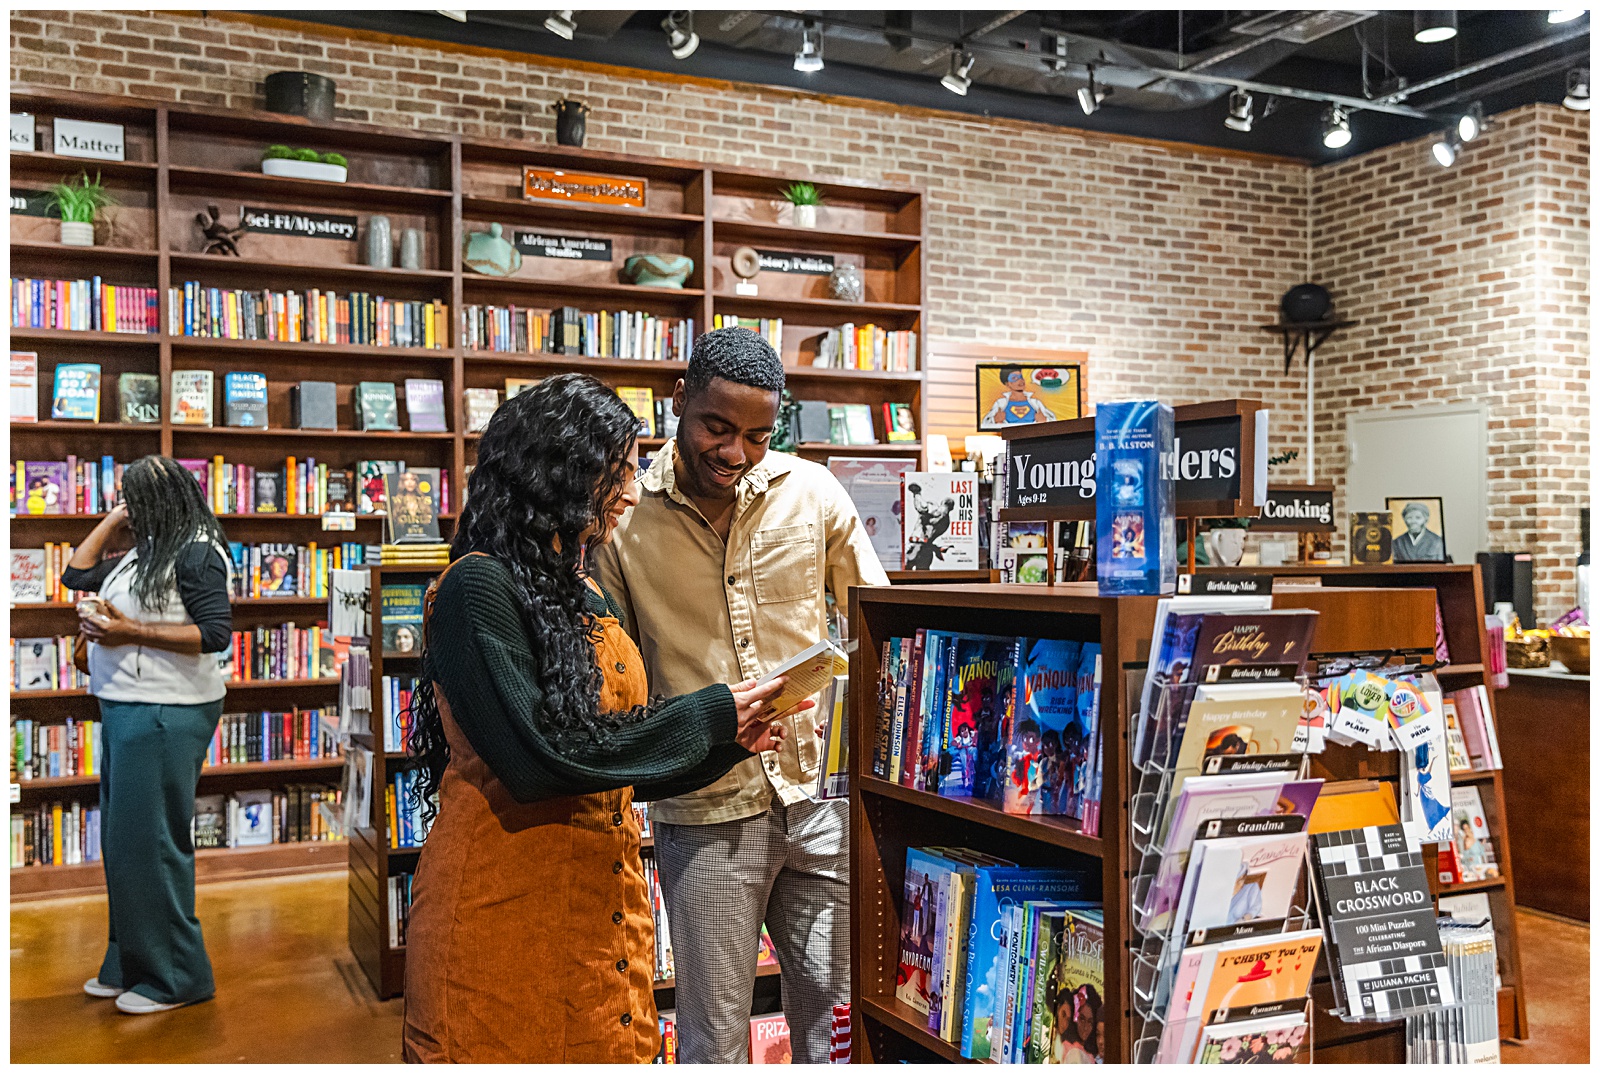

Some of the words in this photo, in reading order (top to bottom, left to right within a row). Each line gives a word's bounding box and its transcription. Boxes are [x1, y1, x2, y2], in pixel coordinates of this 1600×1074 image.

[58, 134, 122, 153] Matter
[247, 213, 356, 238] Sci-Fi/Mystery
[520, 234, 558, 248] African
[560, 238, 606, 251] American
[544, 247, 582, 259] Studies
[1118, 441, 1155, 449] ALSTON
[1013, 453, 1097, 499] Young
[951, 480, 973, 494] LAST
[959, 494, 973, 508] ON
[1018, 494, 1032, 507] Ages
[1032, 493, 1047, 503] 9-12
[958, 509, 973, 521] HIS
[1264, 499, 1331, 524] Cooking
[951, 521, 973, 536] FEET
[261, 543, 296, 556] ELLA
[1206, 580, 1257, 592] Birthday-Male
[1233, 625, 1261, 634] HAPPY
[1212, 631, 1271, 659] Birthday
[1231, 668, 1262, 679] Birthday
[1263, 667, 1281, 677] Male
[1360, 686, 1382, 703] LOVER
[897, 695, 905, 717] ELLIS
[1038, 705, 1074, 716] WRECKING
[942, 690, 953, 750] VANQUISHERS
[1202, 712, 1231, 723] Happy
[1231, 709, 1267, 720] Birthday
[1344, 720, 1370, 734] PLANT
[1410, 725, 1431, 739] PRIDE
[893, 718, 904, 757] JOHNSON
[879, 733, 890, 761] STAR
[1231, 759, 1290, 771] Birthday-Female
[1237, 820, 1285, 833] Grandma
[991, 884, 1010, 893] LESA
[1012, 884, 1080, 893] CLINE-RANSOME
[1354, 876, 1399, 895] BLACK
[1336, 889, 1425, 914] CROSSWORD
[1232, 925, 1254, 935] Mom
[1355, 924, 1370, 935] 100
[1370, 921, 1387, 933] Mini
[1387, 918, 1416, 931] Puzzles
[968, 922, 978, 949] ONE
[1368, 931, 1406, 942] CELEBRATING
[1353, 946, 1365, 954] THE
[1365, 944, 1392, 955] African
[1392, 939, 1427, 954] Diaspora
[966, 950, 976, 971] BIG
[1009, 931, 1019, 985] MONTGOMERY
[1221, 956, 1228, 968] I
[1278, 947, 1296, 958] You
[1370, 977, 1403, 989] JULIANA
[1403, 972, 1431, 984] PACHE
[964, 973, 974, 1006] OPEN
[1250, 1004, 1283, 1015] Romance
[962, 1008, 971, 1030] SKY
[1031, 1004, 1043, 1058] WITCH
